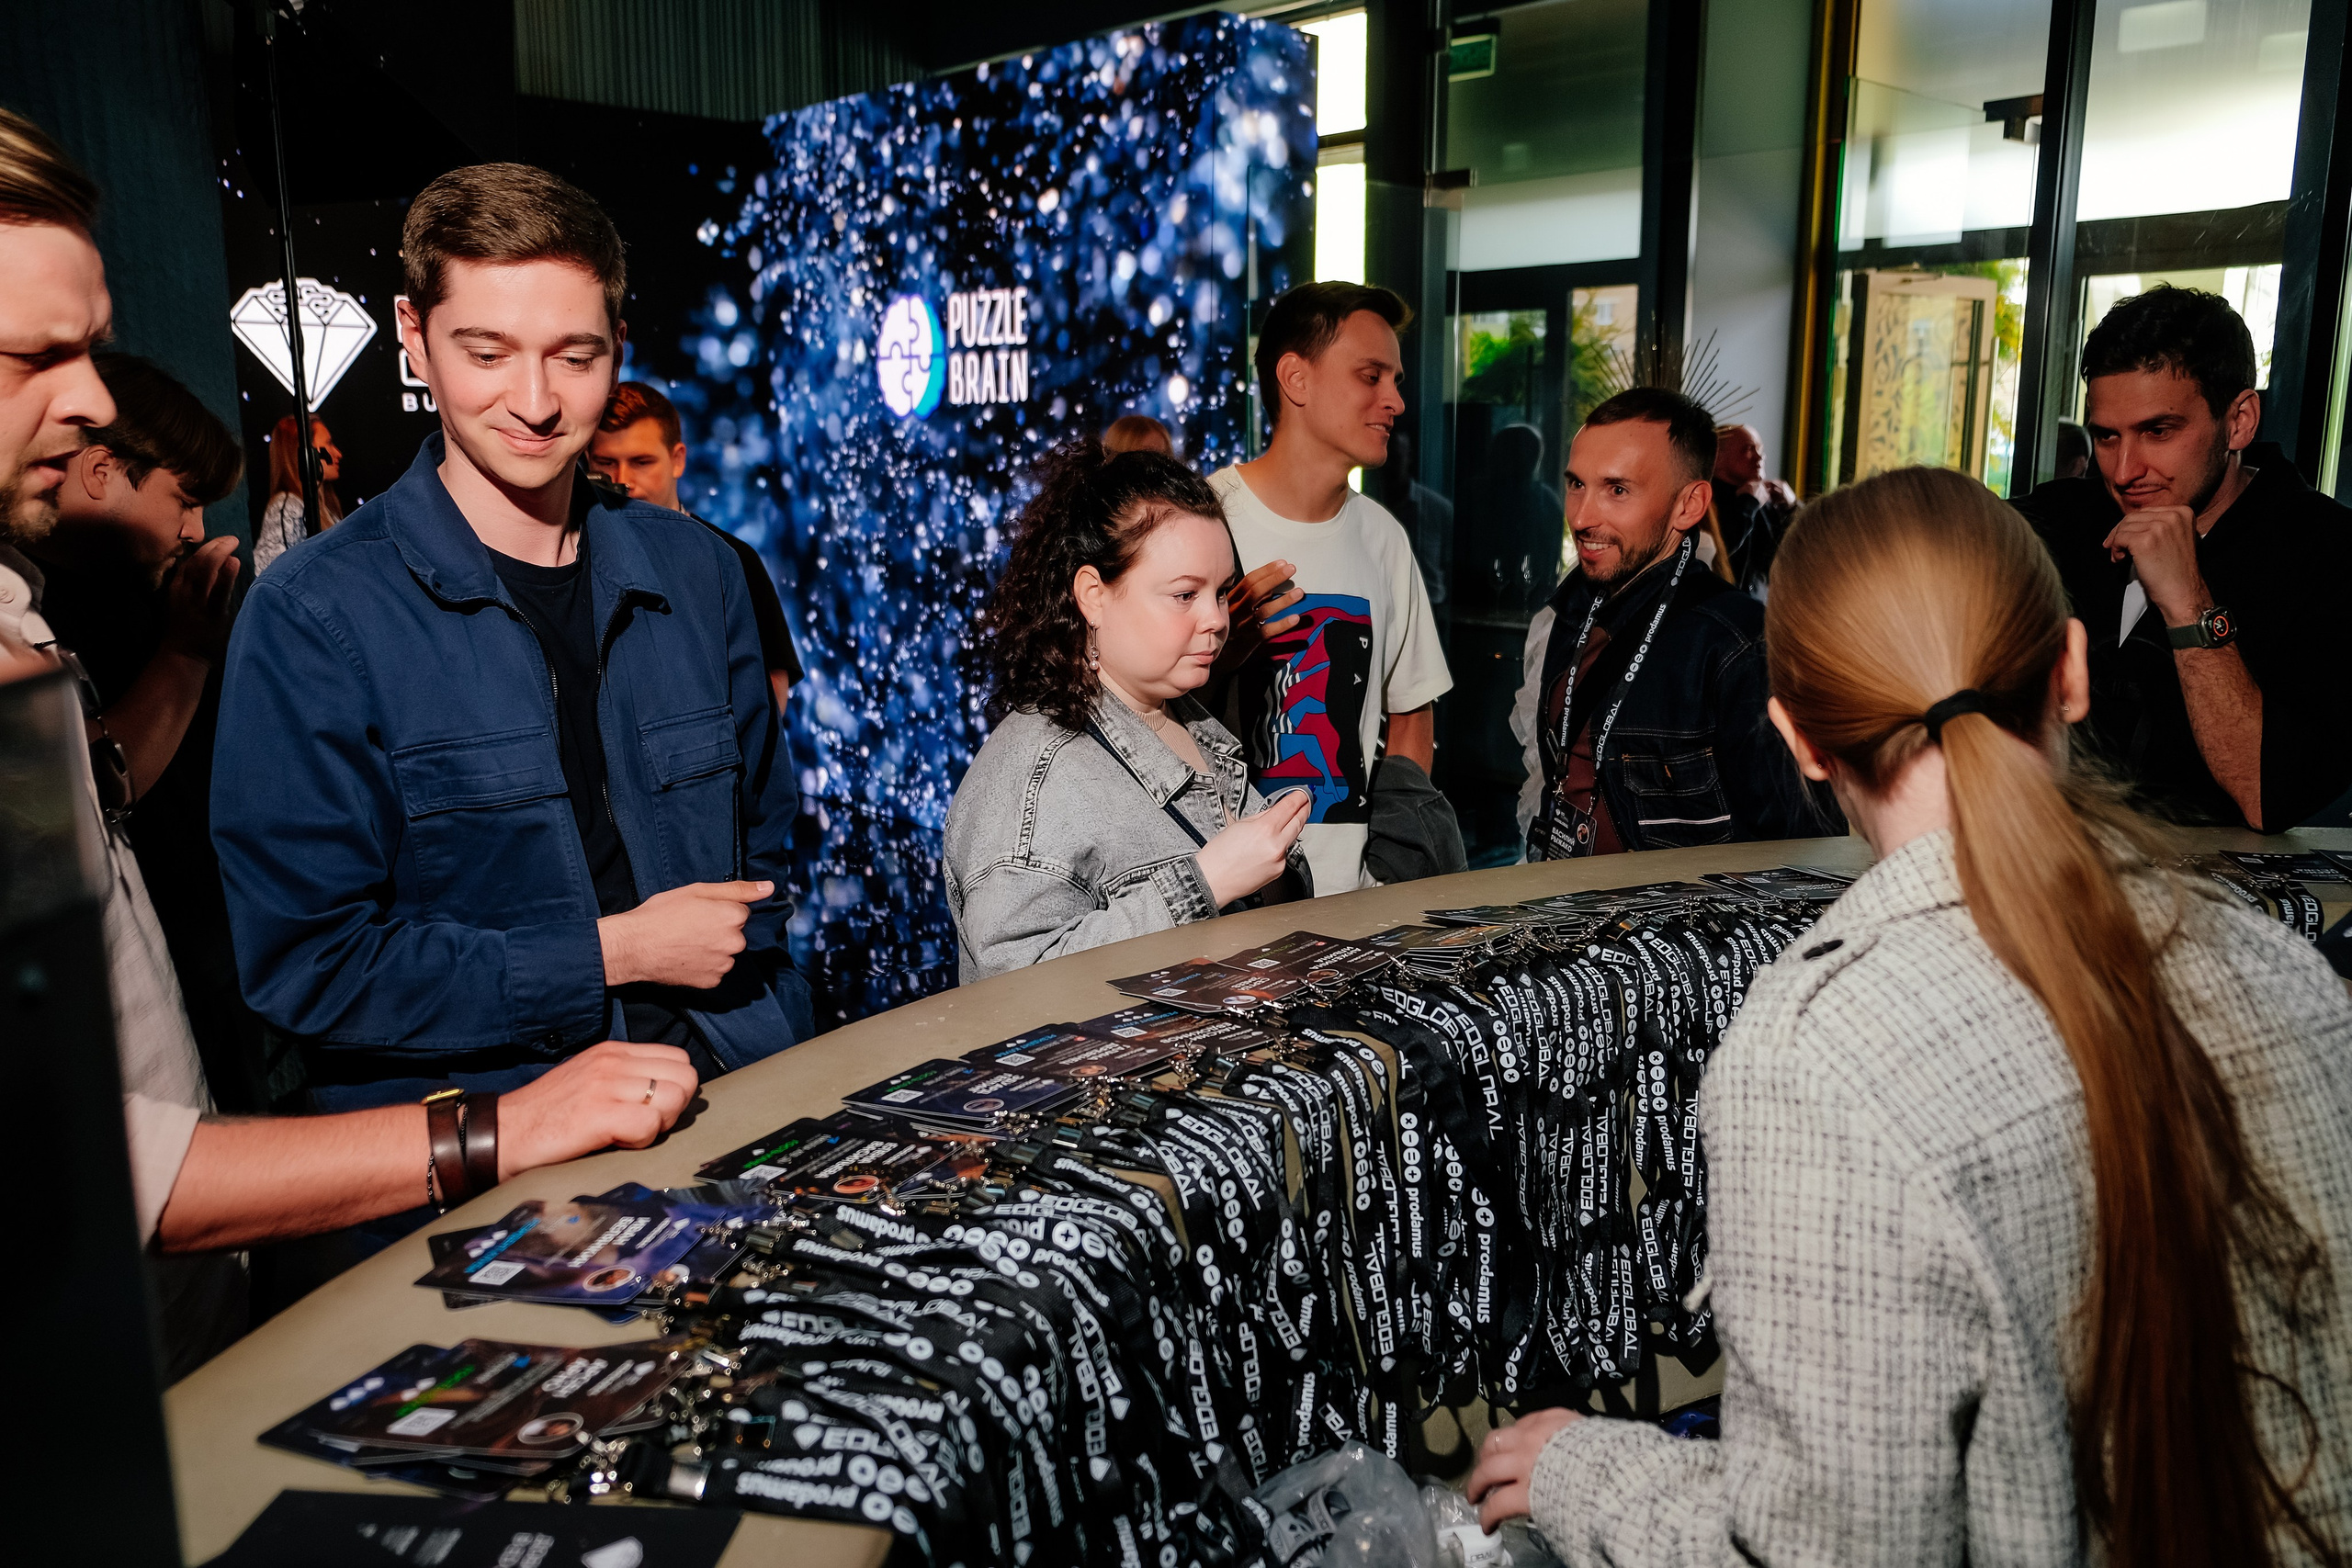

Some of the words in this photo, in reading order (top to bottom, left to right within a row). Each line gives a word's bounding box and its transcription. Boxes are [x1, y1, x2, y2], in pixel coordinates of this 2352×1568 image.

[947, 287, 1028, 348] PUZZLE
[948, 348, 1029, 405] BRAIN
[1645, 603, 1668, 644] prodamus
[1560, 706, 1571, 747] prodamus
[1627, 935, 1662, 982] prodamus
[1684, 931, 1720, 982] prodamus
[1379, 985, 1466, 1076] EDGLOBAL
[1547, 975, 1574, 1034] prodamus
[1330, 1069, 1364, 1139] prodamus
[1164, 1125, 1231, 1178] prodamus
[1177, 1113, 1266, 1212] EDGLOBAL
[1580, 1115, 1596, 1211] EDGLOBAL
[1654, 1114, 1677, 1172] prodamus
[1053, 1156, 1132, 1193] prodamus
[835, 1204, 916, 1244] prodamus
[1404, 1186, 1425, 1259] prodamus
[1364, 1240, 1395, 1356] EDGLOBAL
[1476, 1232, 1492, 1325] prodamus
[1619, 1258, 1638, 1359] EDGLOBAL
[1296, 1371, 1317, 1448] prodamus
[1382, 1401, 1398, 1460] odamus
